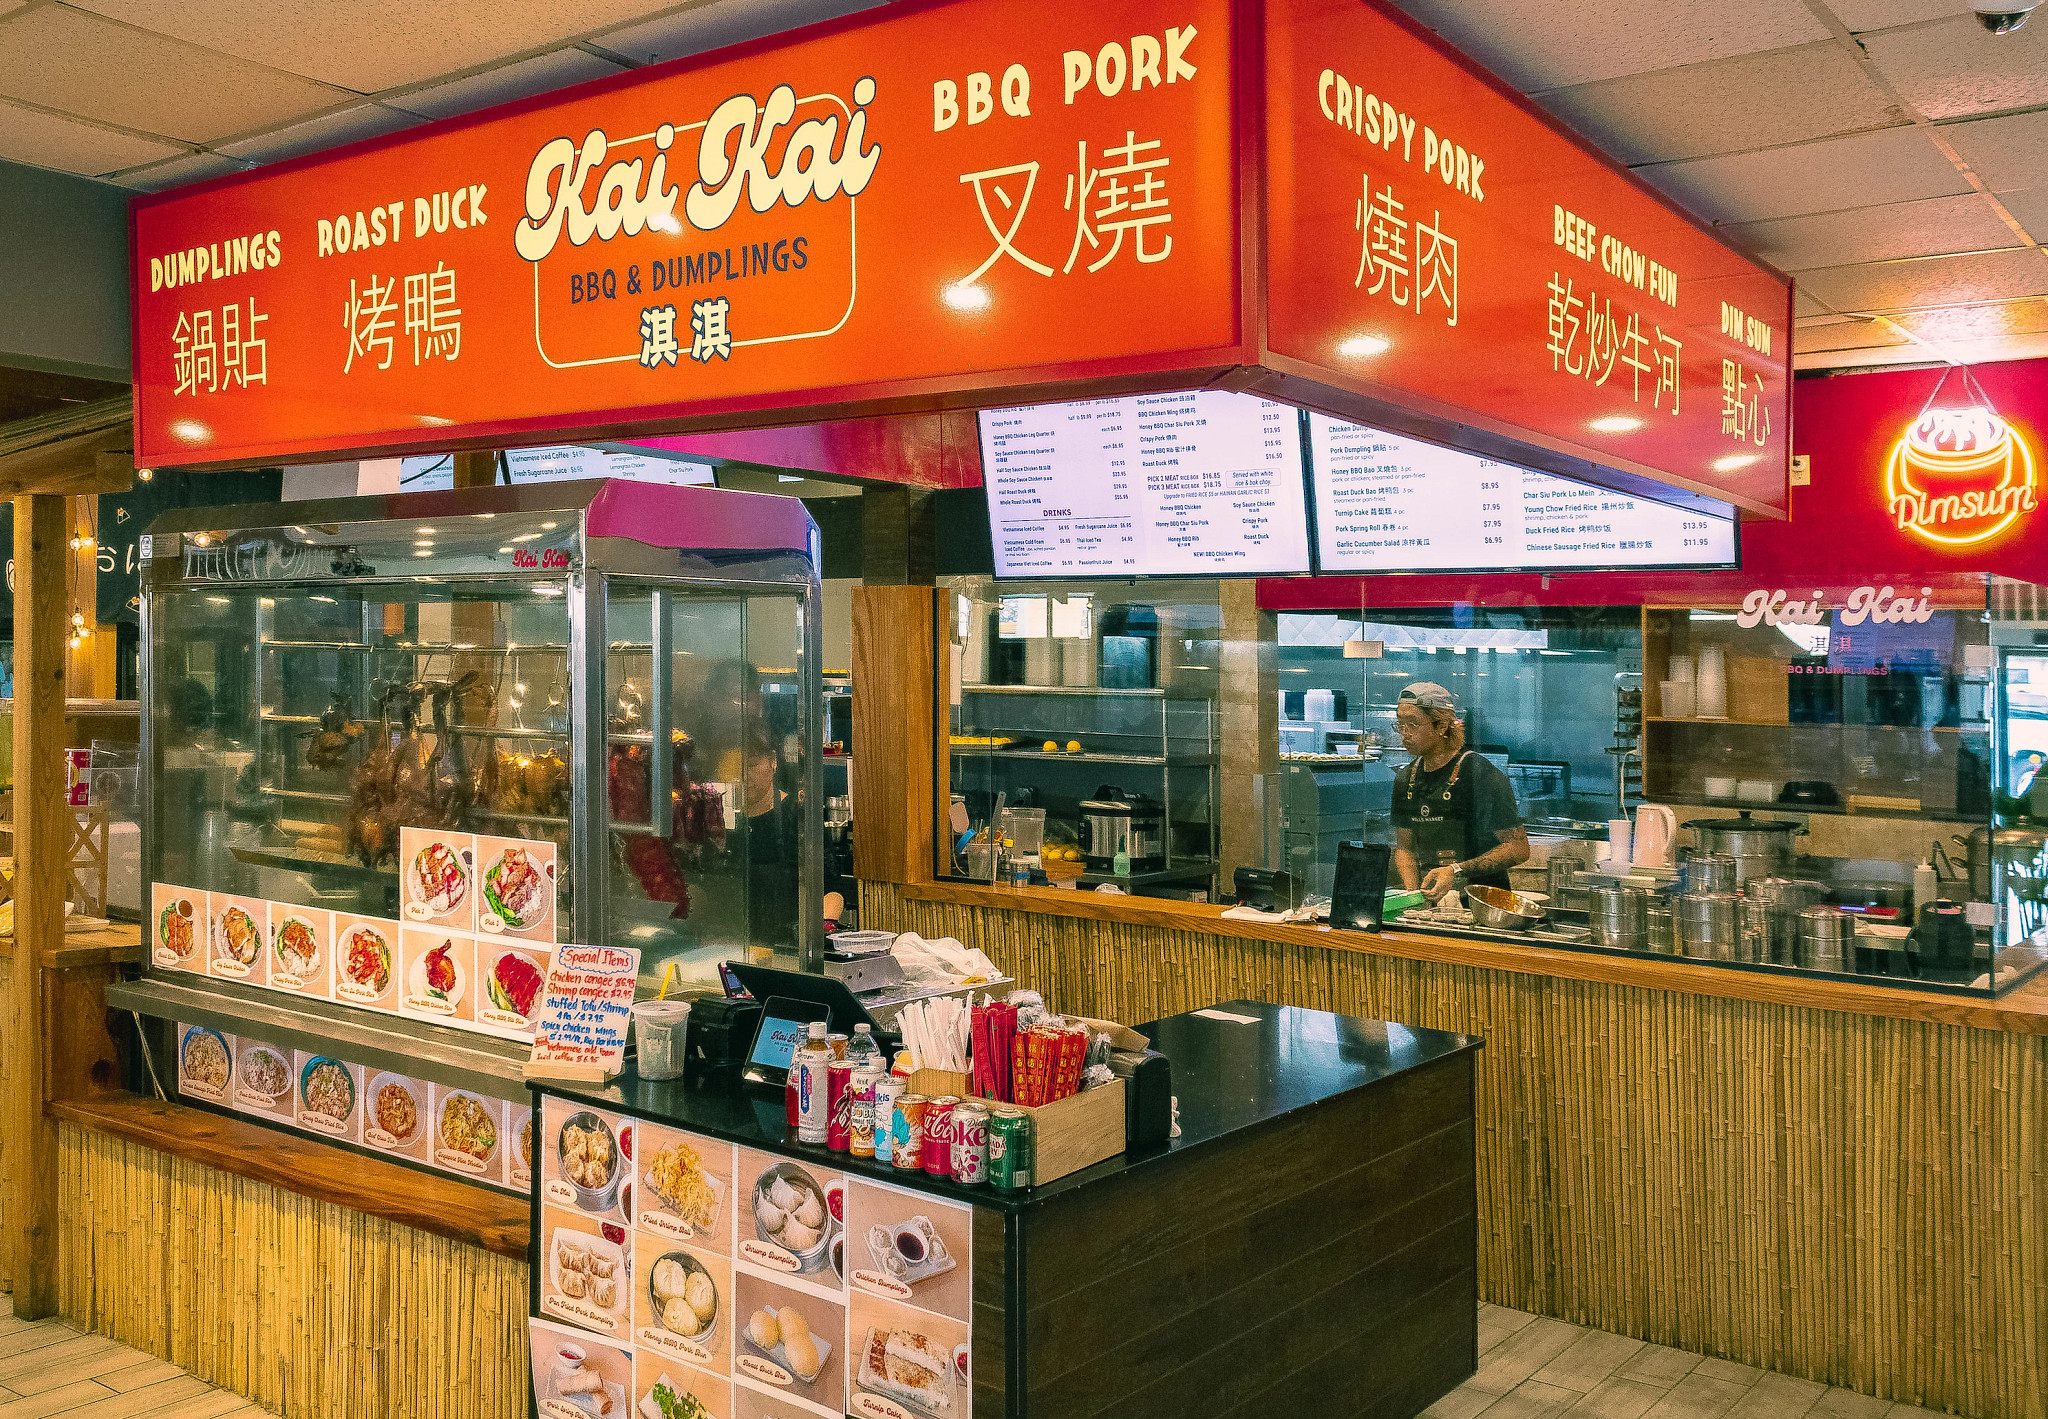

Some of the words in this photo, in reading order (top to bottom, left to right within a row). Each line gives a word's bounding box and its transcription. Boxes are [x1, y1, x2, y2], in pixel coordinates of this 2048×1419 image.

[933, 62, 1031, 133] BBQ
[1062, 23, 1198, 106] PORK
[1318, 69, 1416, 163] CRISPY
[1424, 126, 1485, 203] PORK
[514, 122, 679, 262] Kai
[685, 75, 882, 231] Kai
[958, 130, 1174, 290] 叉燒
[317, 201, 405, 258] ROAST
[415, 183, 489, 238] DUCK
[1355, 173, 1458, 328] 燒肉
[1554, 204, 1597, 263] BEEF
[1601, 234, 1646, 291] CHOW
[1649, 261, 1678, 307] FUN
[151, 230, 281, 293] DUMPLINGS
[570, 268, 618, 305] BBQ
[627, 265, 643, 296] &
[652, 236, 810, 293] DUMPLINGS
[341, 260, 463, 375] 烤鴨
[1721, 301, 1744, 340] DIM
[1748, 313, 1772, 357] SUM
[172, 296, 270, 397] 鍋貼
[1546, 271, 1684, 416] 乾炒牛河
[1721, 358, 1771, 447] 點心
[1329, 425, 1351, 433] Chicken
[1345, 446, 1371, 454] Dumpling
[1481, 482, 1499, 490] $8.95
[1524, 492, 1538, 500] Char
[1043, 509, 1072, 517] DRINKS
[1335, 509, 1353, 517] Turnip
[1524, 506, 1544, 515] Young
[1888, 485, 2039, 531] Dimsum
[1350, 525, 1368, 533] Spring
[1483, 520, 1502, 528] $7.95
[1526, 527, 1541, 535] Duck
[1682, 522, 1708, 530] $13.95
[1484, 537, 1503, 545] $6.95
[1553, 543, 1582, 552] Sausage
[1683, 538, 1709, 547] $11.95
[512, 548, 539, 567] Kai
[542, 548, 569, 568] Kai
[1737, 590, 1825, 629] Kai
[1840, 586, 1935, 626] Kai
[1807, 666, 1813, 674] &
[1817, 666, 1888, 676] DUMPLINGS
[564, 948, 602, 967] Special
[602, 950, 629, 967] Items
[550, 970, 582, 984] chicken
[584, 975, 613, 989] congee
[579, 987, 609, 1001] congee
[643, 1214, 659, 1227] Fried
[659, 1219, 679, 1234] Shrimp
[745, 1243, 767, 1260] Shrimp
[767, 1250, 798, 1268] Dumpling
[855, 1271, 877, 1286] Chicken
[877, 1277, 908, 1295] Dumplings
[863, 1398, 885, 1415] Turnip
